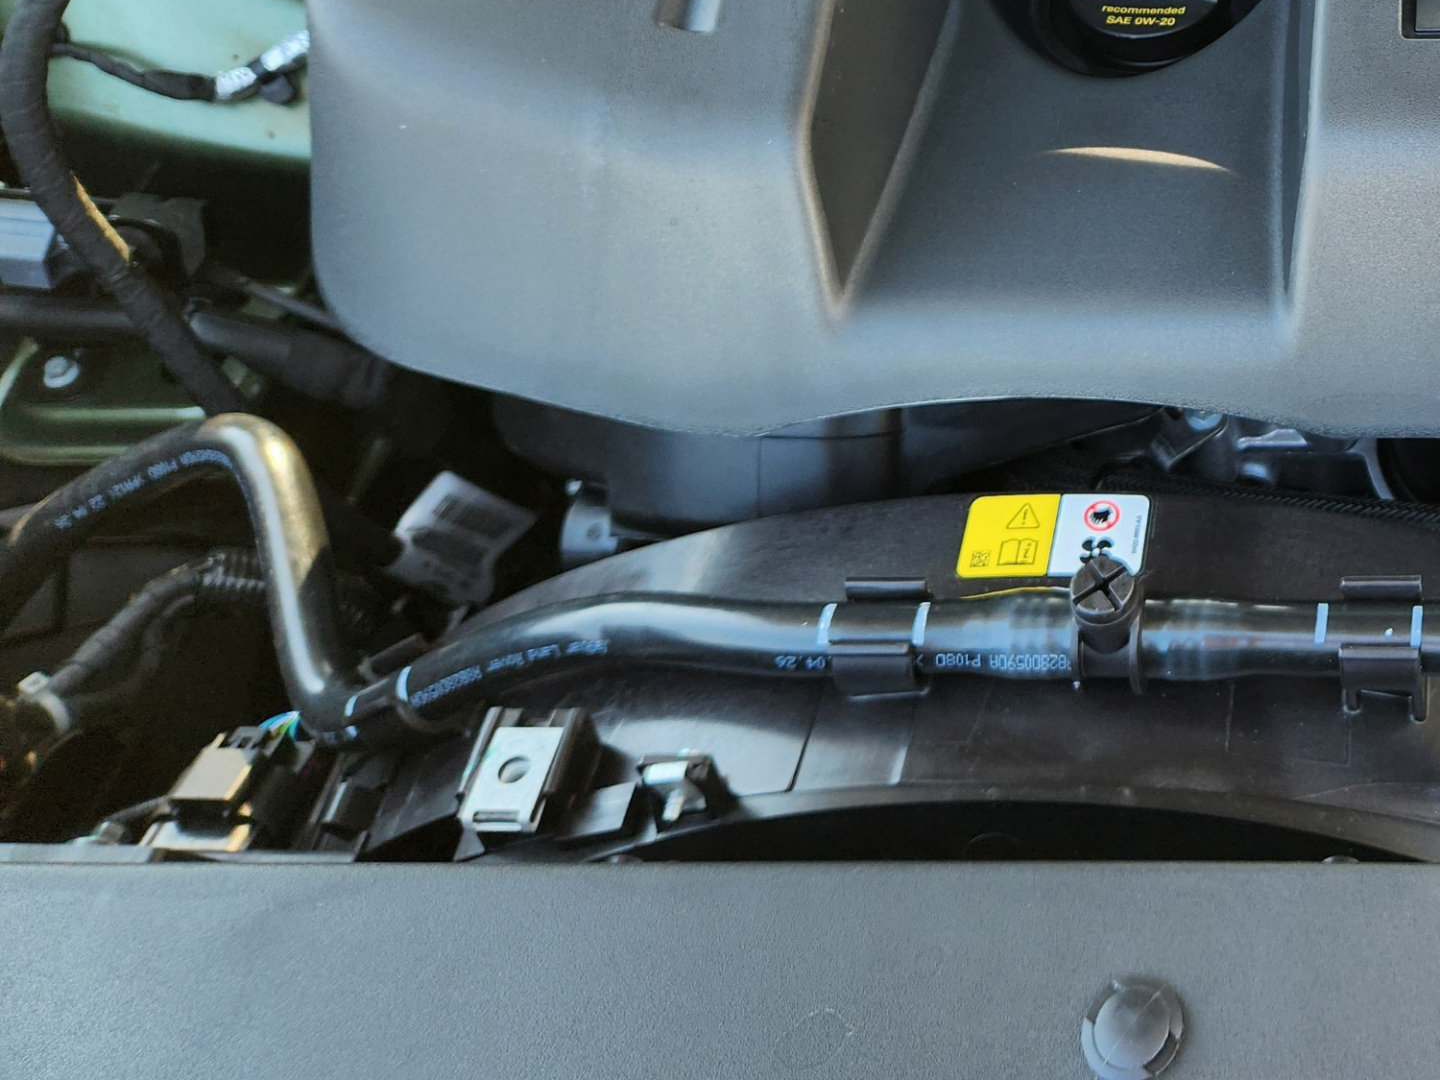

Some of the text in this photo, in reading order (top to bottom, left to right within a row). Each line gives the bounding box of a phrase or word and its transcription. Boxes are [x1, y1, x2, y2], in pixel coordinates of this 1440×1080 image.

[1102, 5, 1187, 16] recommended
[1106, 15, 1177, 27] SAE 0W-20
